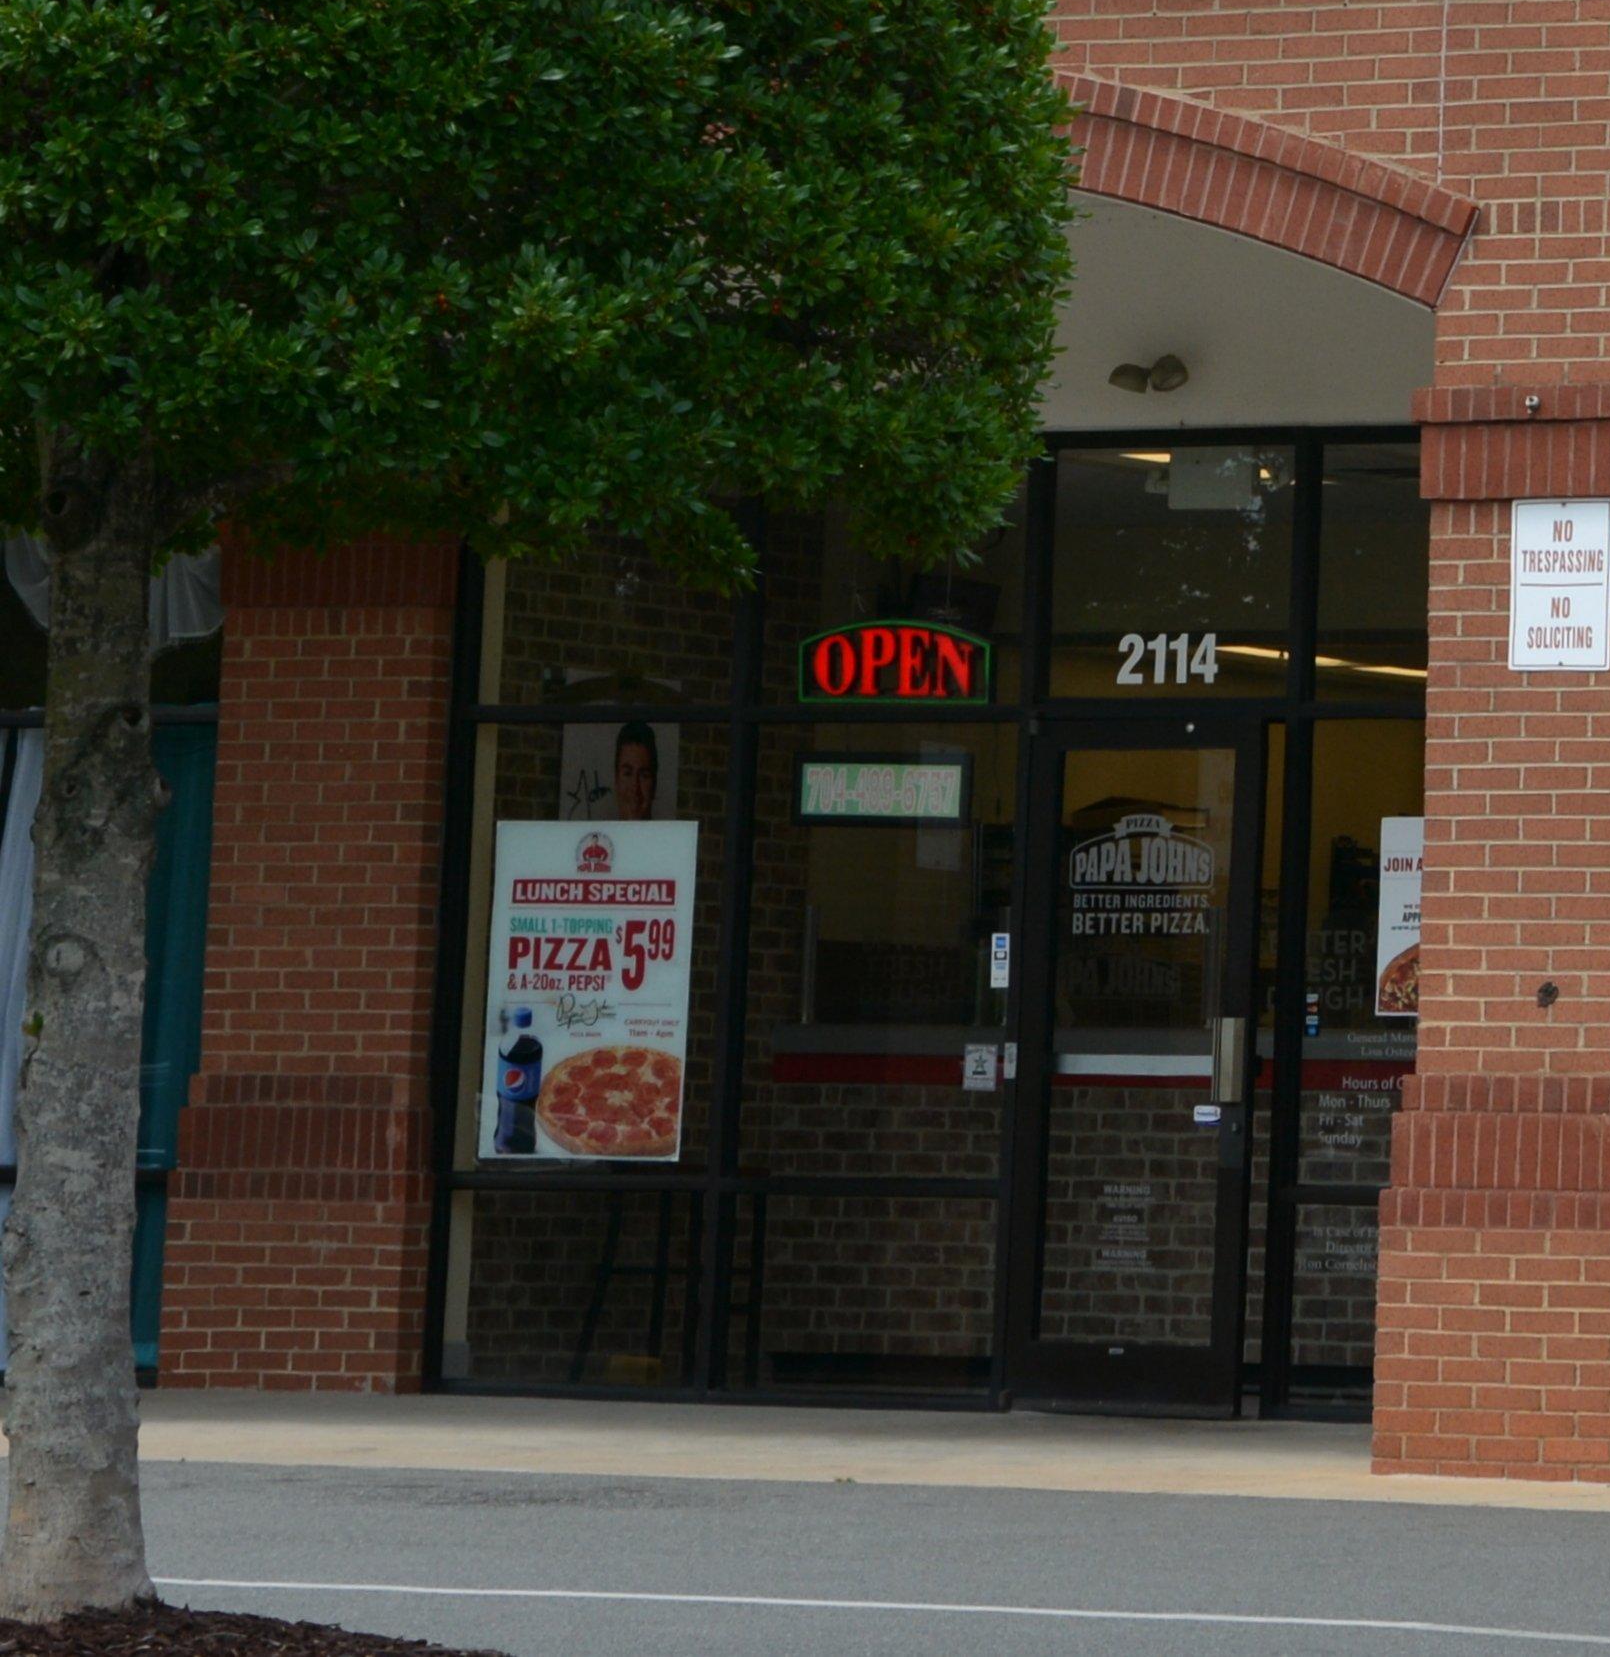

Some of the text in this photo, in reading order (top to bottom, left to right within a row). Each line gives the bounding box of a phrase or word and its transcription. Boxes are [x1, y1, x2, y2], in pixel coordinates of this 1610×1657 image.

[1553, 519, 1573, 542] NO
[1521, 549, 1604, 573] TRESPASSING
[1551, 596, 1571, 619] NO
[1527, 626, 1593, 649] SOLICITING
[812, 625, 974, 699] OPEN
[1116, 632, 1219, 686] 2114
[1126, 817, 1161, 829] PIZZA
[1074, 838, 1133, 883] PAPA
[1384, 857, 1413, 872] JOIN
[514, 882, 672, 903] LUNCH SPECIAL
[1073, 894, 1120, 908] BETTER
[510, 917, 613, 935] SMALL 1-TOPPING
[1072, 912, 1210, 934] BETTER PIZZA.
[508, 937, 612, 971] PIZZA
[507, 974, 517, 990] &
[568, 975, 606, 991] PEPSI
[1343, 1076, 1379, 1090] Hours
[1381, 1076, 1396, 1090] of
[1319, 1095, 1346, 1108] Mon
[1357, 1095, 1391, 1109] Thurs
[1319, 1113, 1335, 1126] Fri
[1345, 1113, 1364, 1126] Sat
[1318, 1132, 1362, 1148] Sunday
